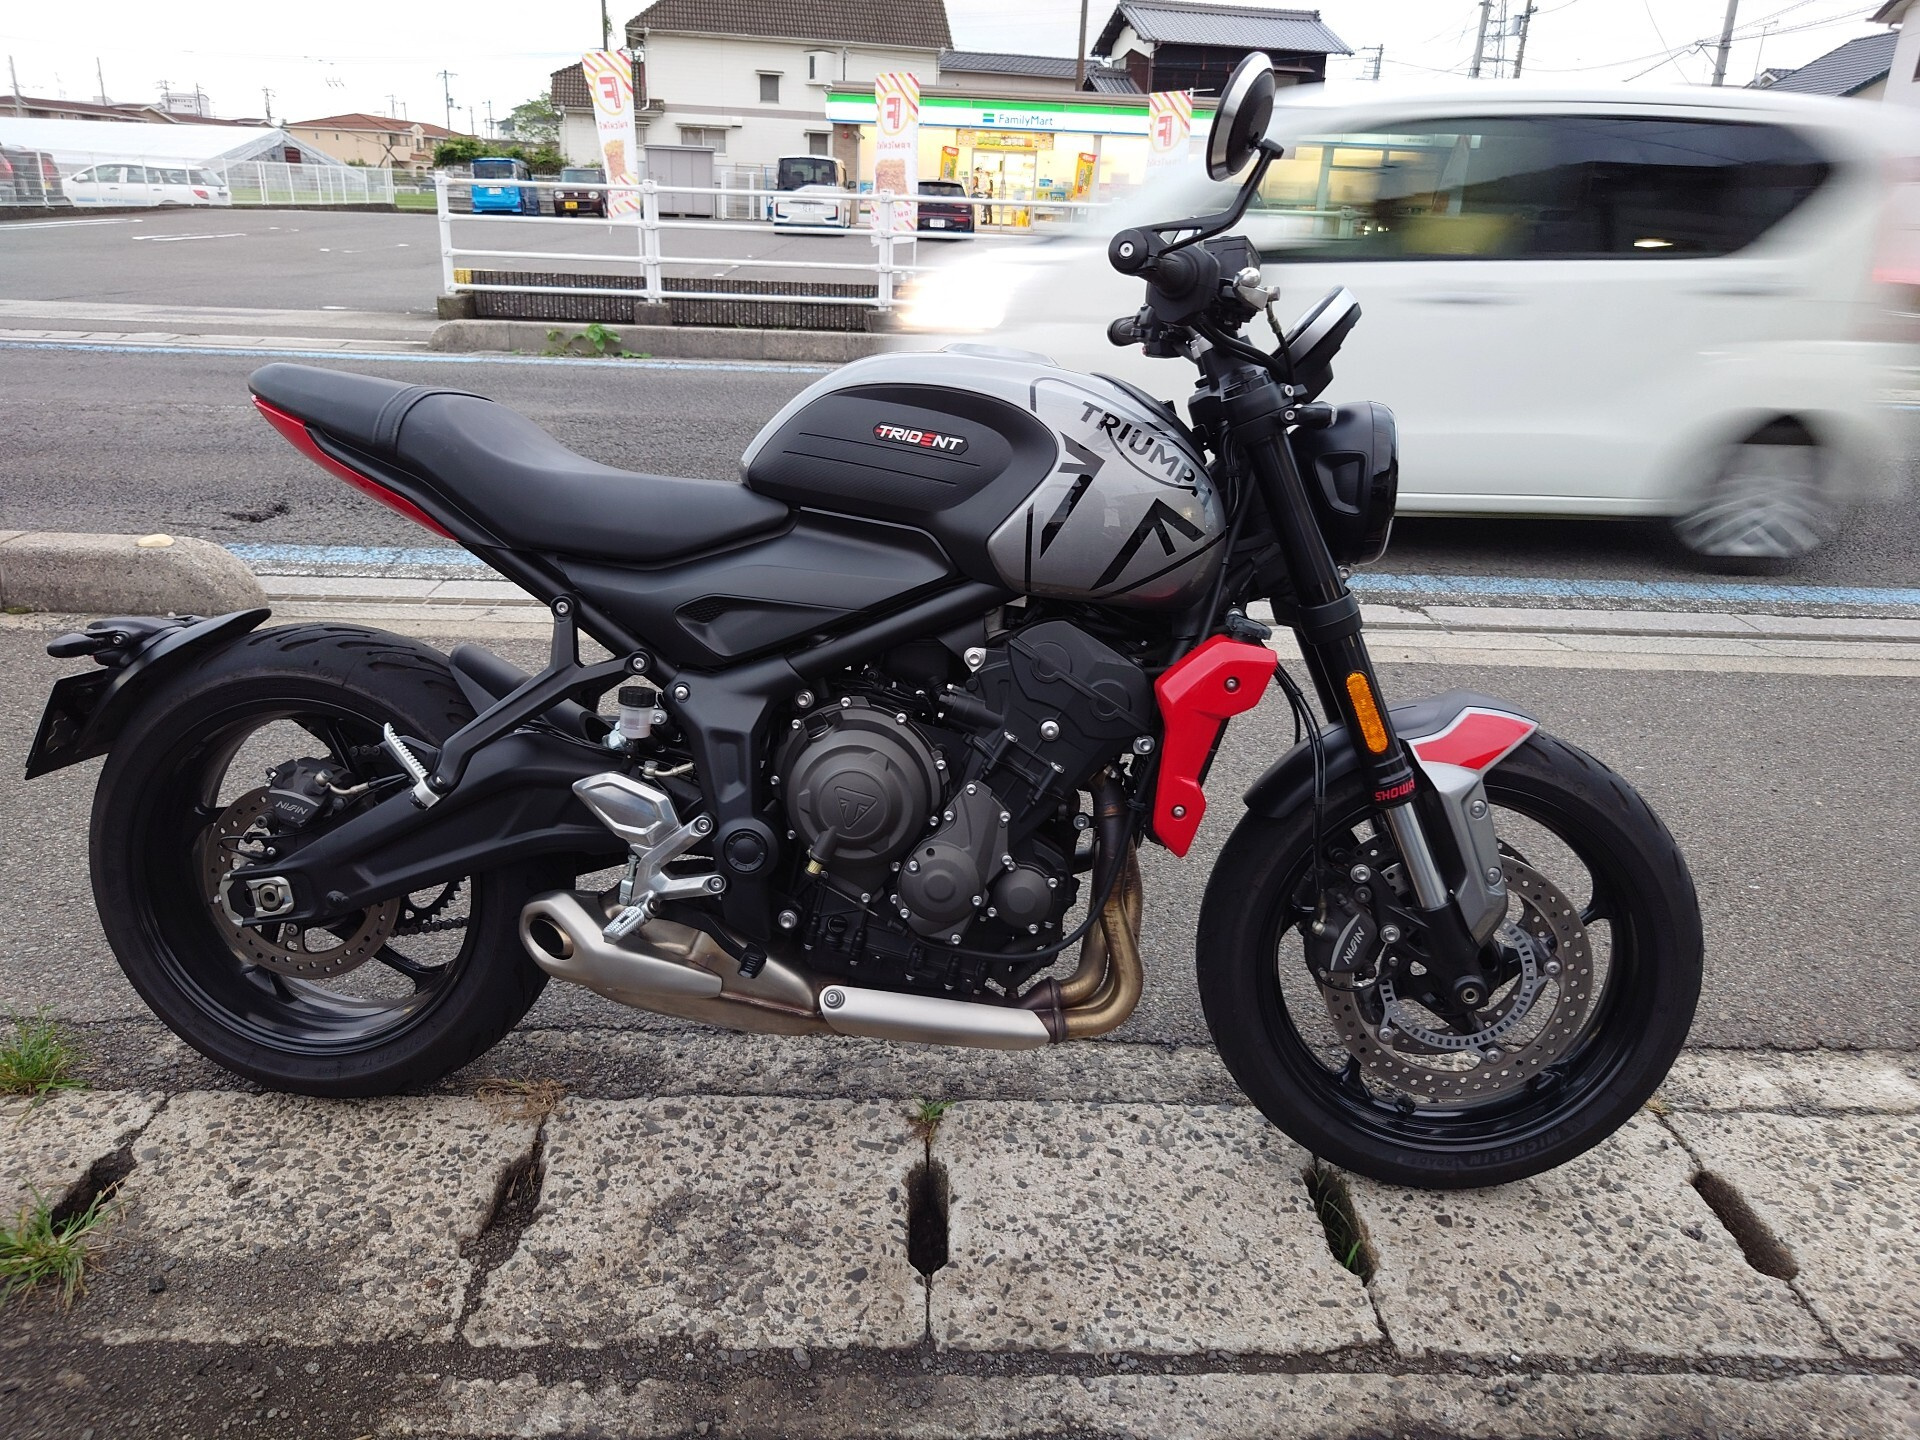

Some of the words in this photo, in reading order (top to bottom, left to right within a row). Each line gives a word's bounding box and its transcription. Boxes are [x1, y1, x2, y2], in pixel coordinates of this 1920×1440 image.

[999, 113, 1053, 127] FamilyMart
[879, 424, 964, 451] TRIDENT
[1080, 401, 1213, 507] TRIUMPH
[1375, 778, 1416, 802] SHOWA
[275, 800, 309, 815] NISSIN
[1342, 926, 1365, 965] NISSIN
